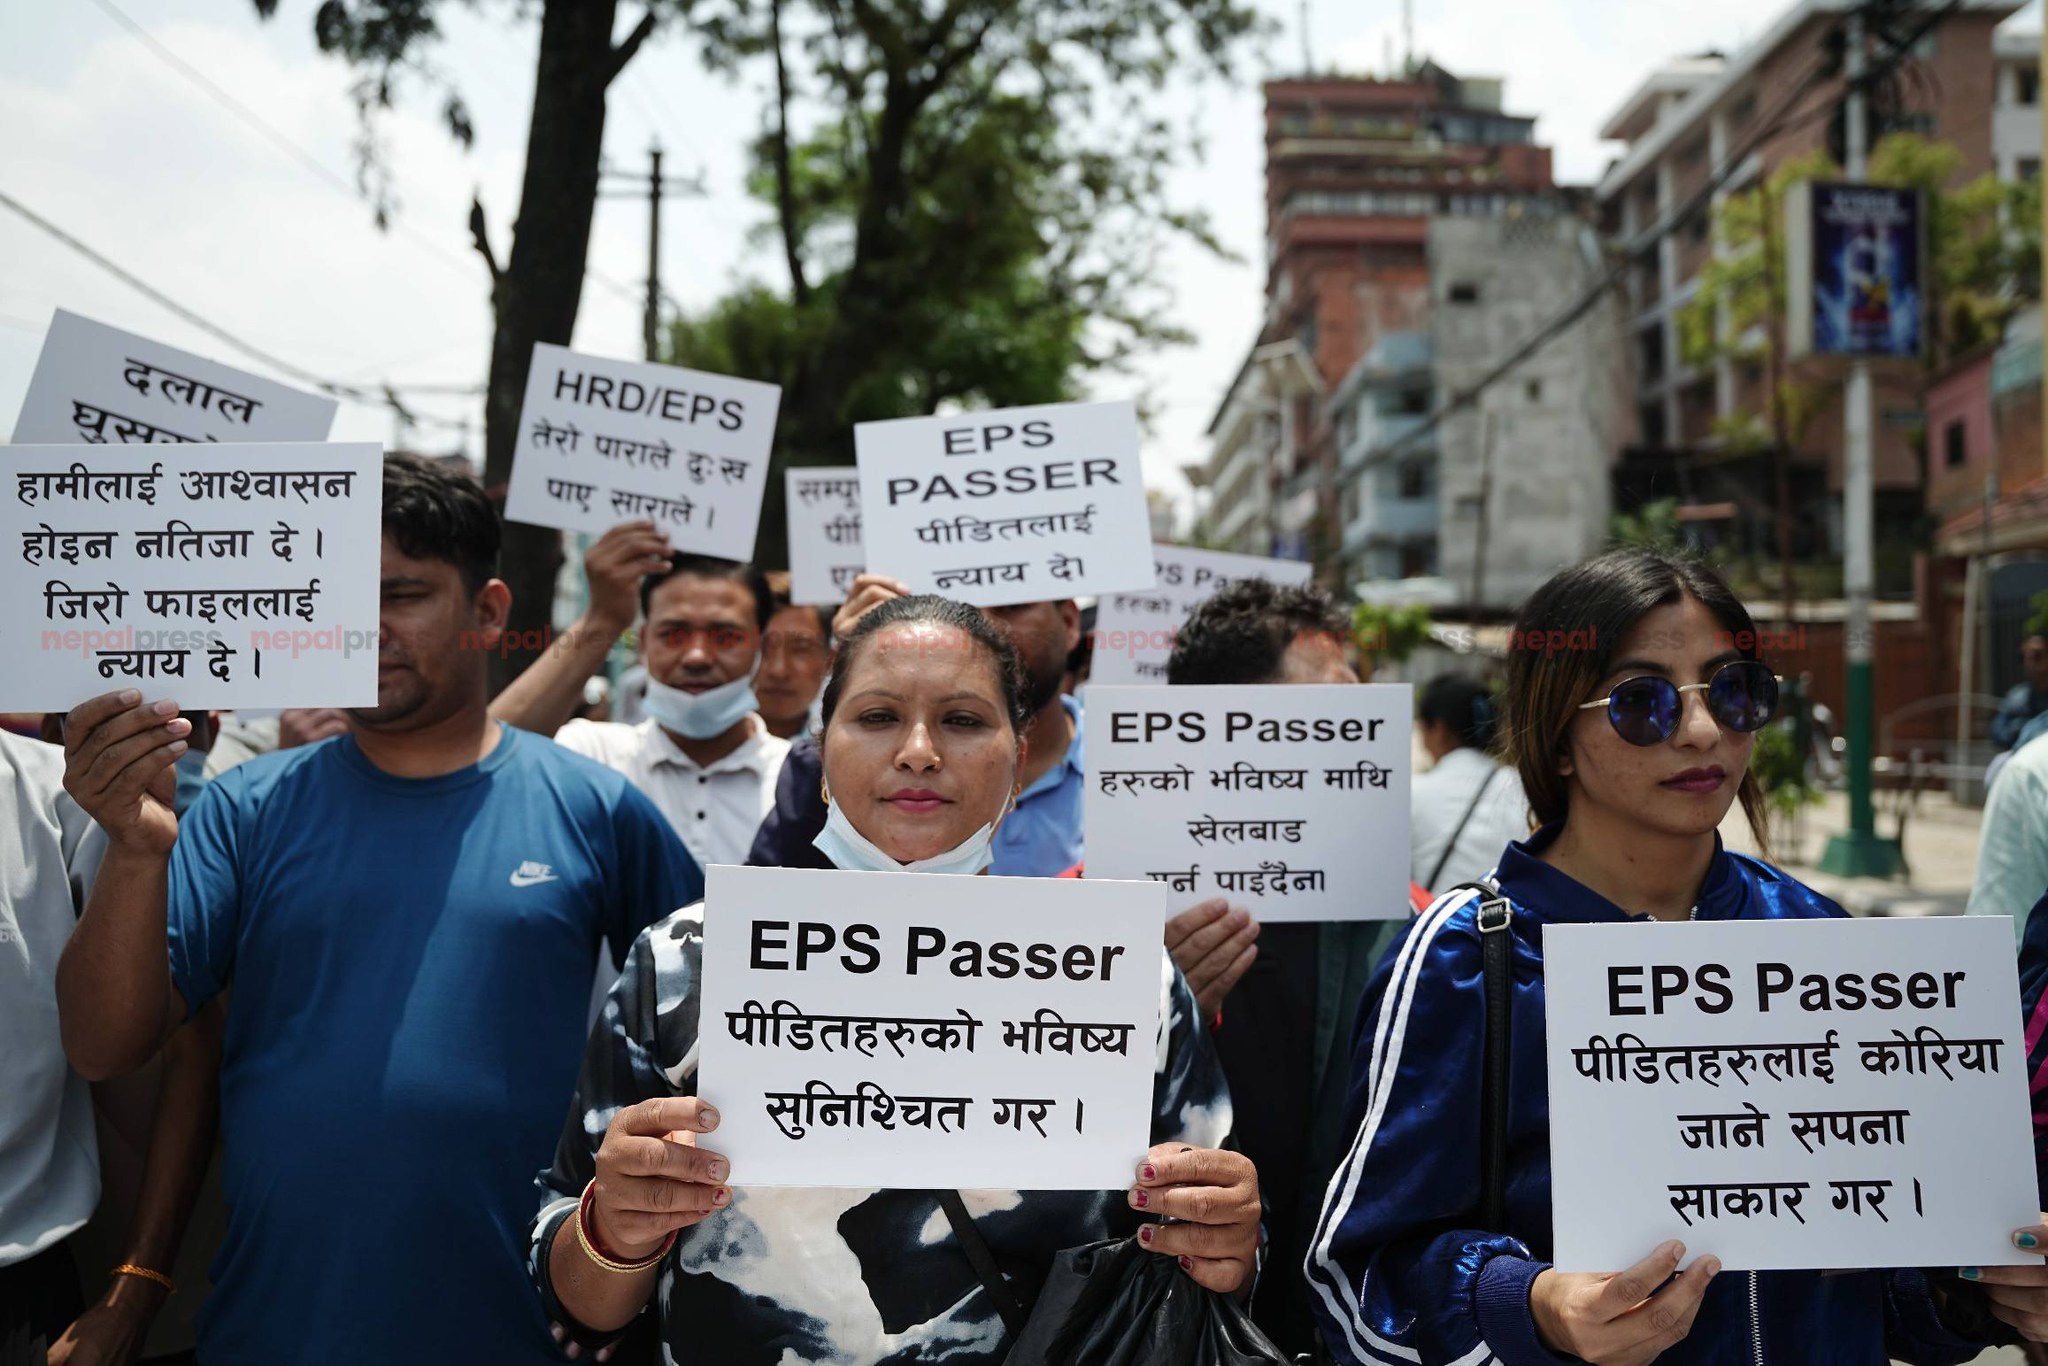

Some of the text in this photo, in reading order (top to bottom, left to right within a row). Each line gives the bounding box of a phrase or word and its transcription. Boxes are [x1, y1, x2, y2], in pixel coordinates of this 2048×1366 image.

[123, 357, 263, 423] दलाल
[554, 369, 745, 431] HRD/EPS
[532, 419, 581, 451] तेरो
[595, 435, 674, 467] पाराले
[944, 421, 1054, 456] EPS
[17, 463, 357, 507] हामीलाई आश्वासन
[547, 478, 596, 512] पाए
[611, 492, 695, 524] साराले
[888, 458, 1121, 506] PASSER
[22, 523, 119, 566] होइन
[135, 520, 254, 561] नतिजा
[270, 521, 299, 562] दे
[916, 504, 1096, 544] पीडितलाई
[933, 563, 1029, 589] न्याय
[43, 579, 321, 624] जिरो फाइललाई
[96, 650, 191, 678] न्याय
[207, 640, 237, 682] दे
[1112, 712, 1384, 743] EPS Passer
[1099, 760, 1392, 796] हरुको भविष्य माथि
[1187, 814, 1307, 846] खेलबाड
[750, 920, 1125, 981] EPS Passer
[1608, 963, 1966, 1016] EPS Passer
[725, 1000, 1136, 1058] पीडितहरुको भविष्य
[1571, 1026, 2004, 1087] पीडितहरुलाई कोरिया
[764, 1080, 974, 1140] सुनिश्चित
[992, 1099, 1056, 1138] गर
[1677, 1102, 1910, 1154] जाने सपना
[1667, 1182, 1810, 1227] साकार
[1828, 1180, 1893, 1223] गर
